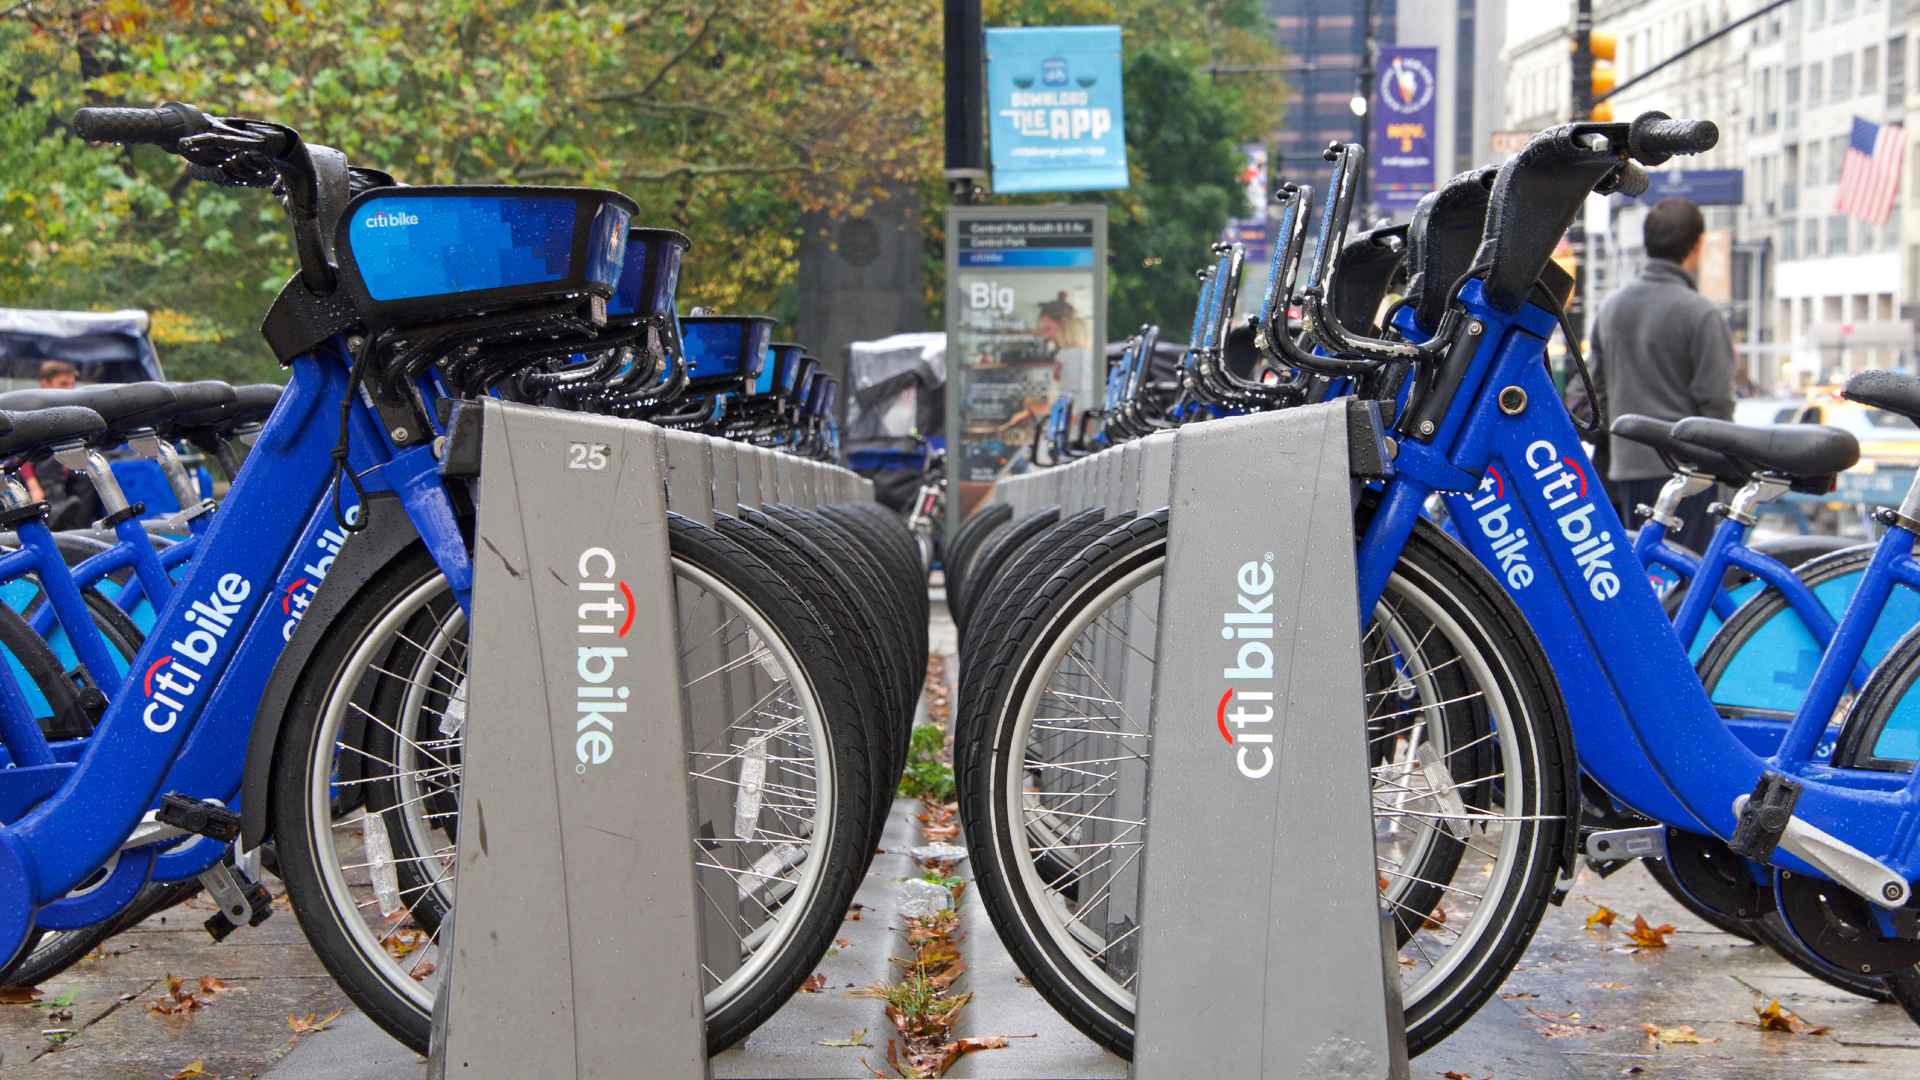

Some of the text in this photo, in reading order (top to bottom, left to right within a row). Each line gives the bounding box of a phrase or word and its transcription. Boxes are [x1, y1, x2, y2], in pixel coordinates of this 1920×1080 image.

[1011, 92, 1088, 107] DOWNLOAD
[999, 108, 1111, 139] THE APP
[366, 212, 419, 228] citi bike
[969, 222, 1003, 234] Central
[1005, 222, 1027, 233] Park
[1028, 222, 1054, 233] South
[969, 236, 1027, 248] Central Park
[970, 281, 1015, 314] Big
[569, 444, 607, 470] 25
[1526, 440, 1620, 601] citi bike
[1478, 503, 1534, 590] bike
[578, 547, 635, 639] citi
[143, 573, 250, 733] citi bike
[1217, 687, 1274, 779] citi
